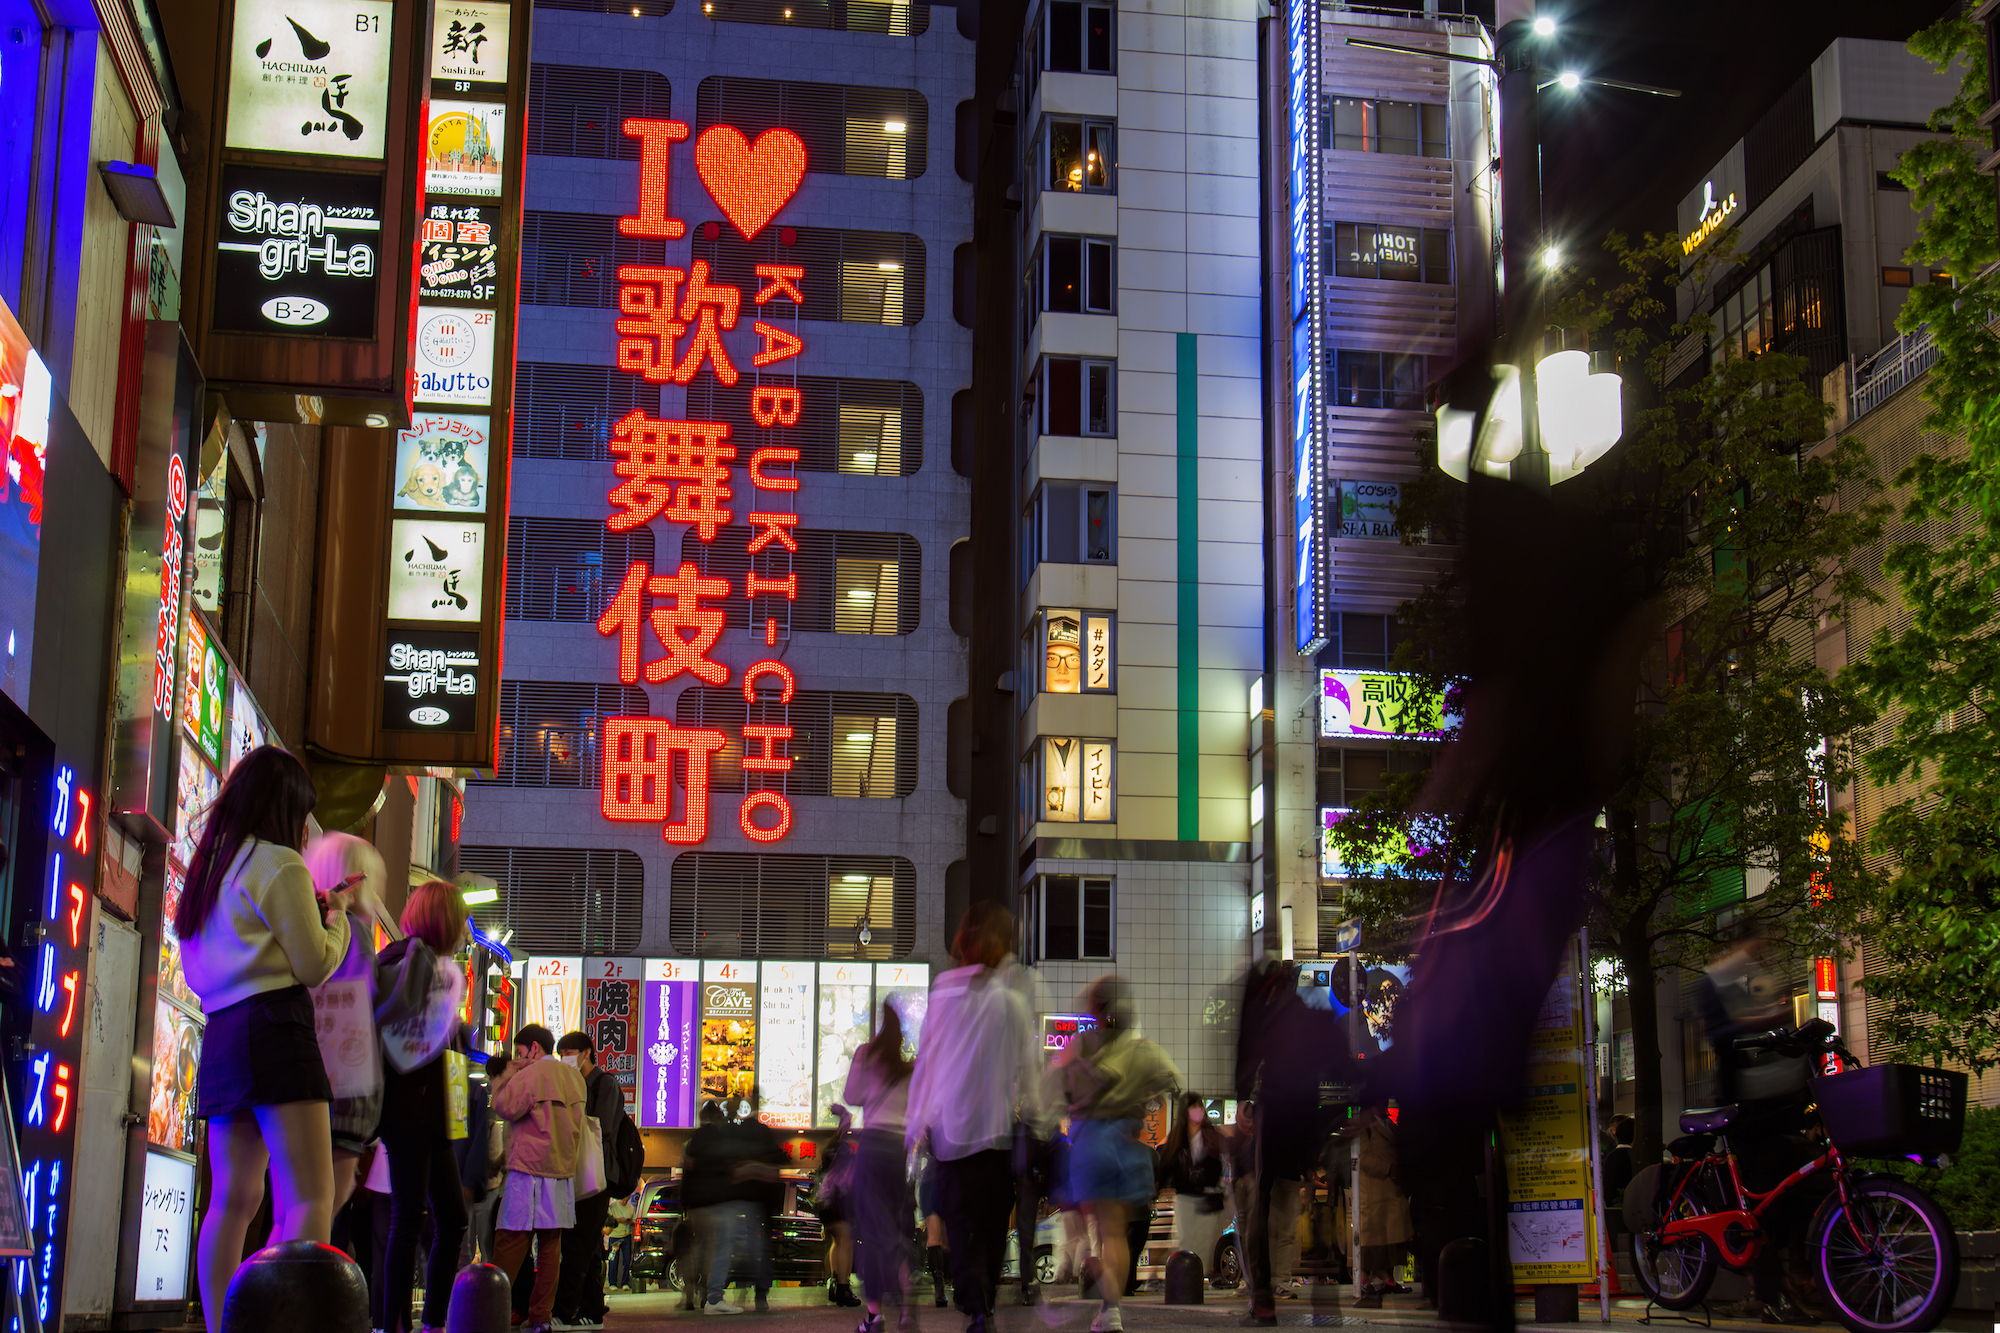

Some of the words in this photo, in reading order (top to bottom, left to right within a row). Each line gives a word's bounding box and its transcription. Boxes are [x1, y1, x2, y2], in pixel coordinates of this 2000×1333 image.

[356, 14, 379, 33] B1
[442, 20, 488, 64] 新
[262, 61, 328, 75] HACHIUMA
[262, 73, 309, 85] 創作料理
[441, 65, 467, 75] Sushi
[469, 67, 486, 76] Bar
[454, 80, 471, 92] 5F
[432, 119, 462, 146] CASITA
[1290, 0, 1307, 291] ラオケ&パーティー
[617, 117, 690, 241] I
[425, 185, 496, 196] el:03-3200-1103
[228, 190, 325, 238] Shan
[326, 205, 375, 218] シャングリラ
[430, 205, 480, 220] 隠れ家
[421, 218, 492, 245] 個室
[259, 233, 375, 280] gri-La
[421, 258, 455, 278] omo
[426, 269, 469, 288] Domo
[472, 284, 496, 300] 3F
[275, 301, 316, 321] B-2
[474, 313, 494, 325] 2F
[1296, 366, 1314, 588] 747
[462, 531, 478, 543] B1
[597, 259, 742, 846] 歌舞伎町
[739, 263, 806, 844] KABUKI-CHO
[408, 563, 447, 571] HACHIUMA
[389, 642, 447, 671] Shan
[446, 650, 476, 658] シャングリラ
[1093, 628, 1106, 685] #タダノ
[408, 668, 476, 698] gri-La
[1362, 679, 1410, 703] 高収
[417, 710, 442, 722] B-2
[1091, 748, 1103, 804] イイヒト
[54, 789, 91, 1133] スマブラ
[538, 960, 569, 976] M2F
[604, 961, 623, 977] 2F
[662, 962, 681, 978] 3F
[720, 963, 738, 979] 4F
[836, 966, 854, 982] 6F
[706, 985, 753, 1007] CAVE
[763, 1001, 790, 1010] Shiha
[586, 987, 596, 1040] BBQ
[596, 980, 631, 1052] 焼肉
[657, 984, 671, 1040] DREAM
[682, 1022, 690, 1052] イベント
[681, 1058, 689, 1085] スペース
[656, 1066, 668, 1123] STORE
[145, 1184, 185, 1214] シャングリラ
[1513, 1201, 1578, 1212] 自転車保管場所
[39, 1159, 62, 1322] ができる
[155, 1228, 169, 1252] アミ
[156, 1277, 163, 1291] B2
